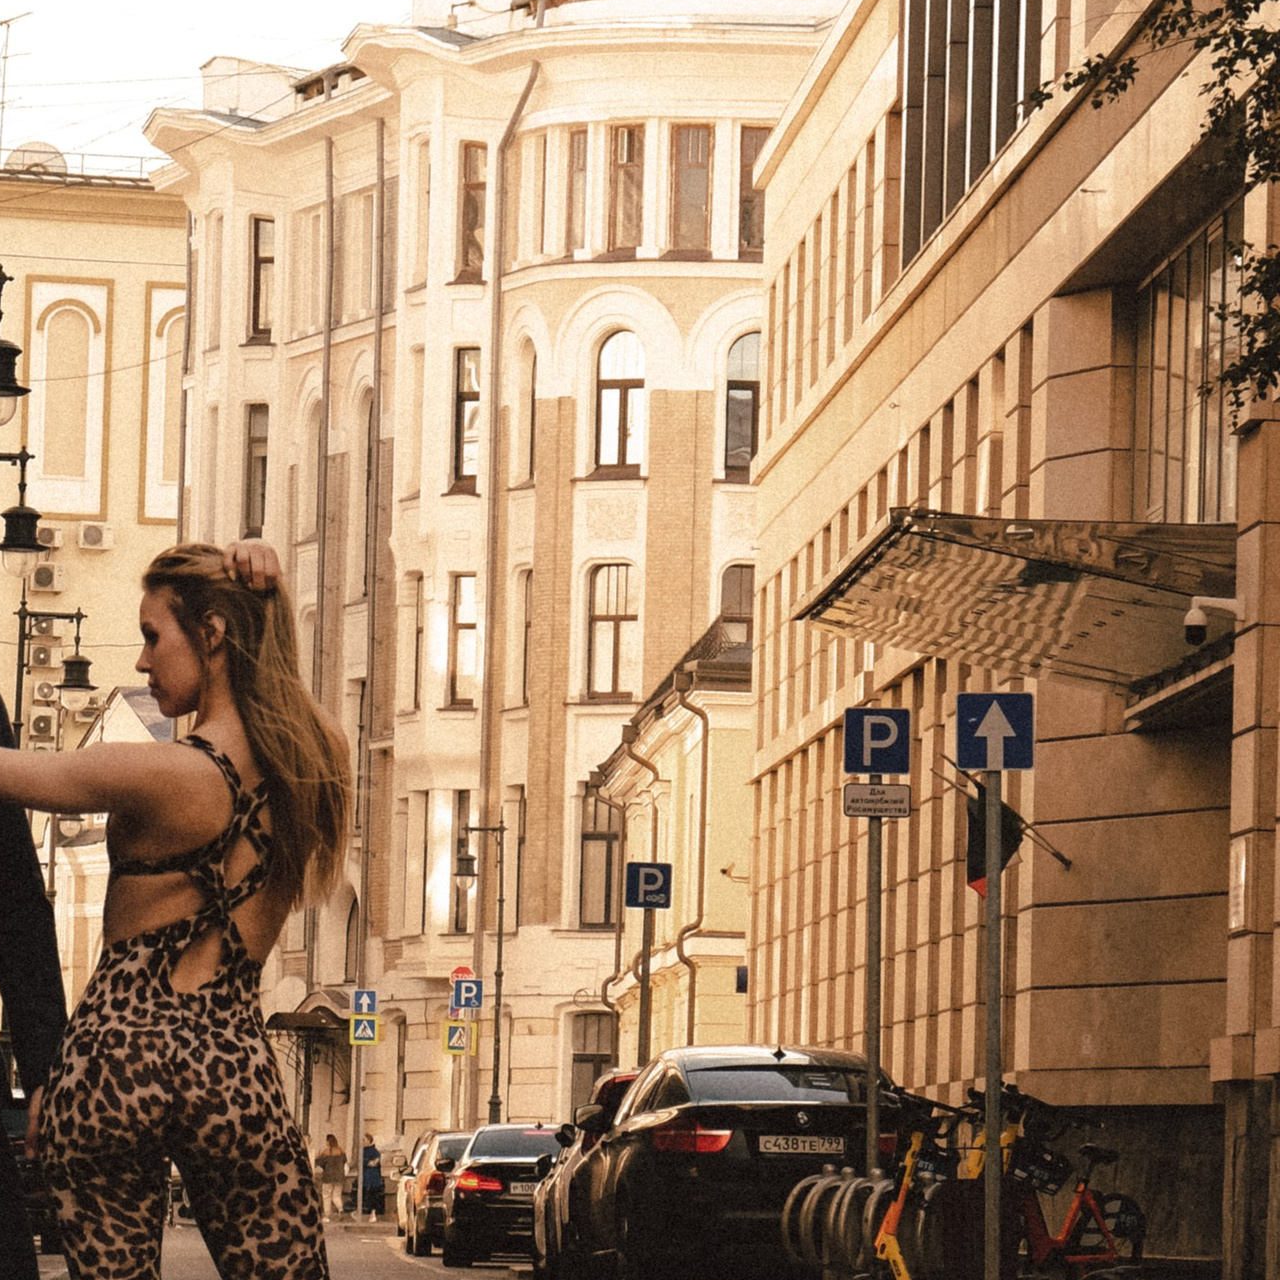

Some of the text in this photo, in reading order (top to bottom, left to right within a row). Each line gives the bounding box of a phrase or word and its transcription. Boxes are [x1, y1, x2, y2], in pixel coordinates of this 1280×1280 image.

[863, 715, 898, 766] P
[638, 867, 664, 903] P
[461, 982, 478, 1005] P
